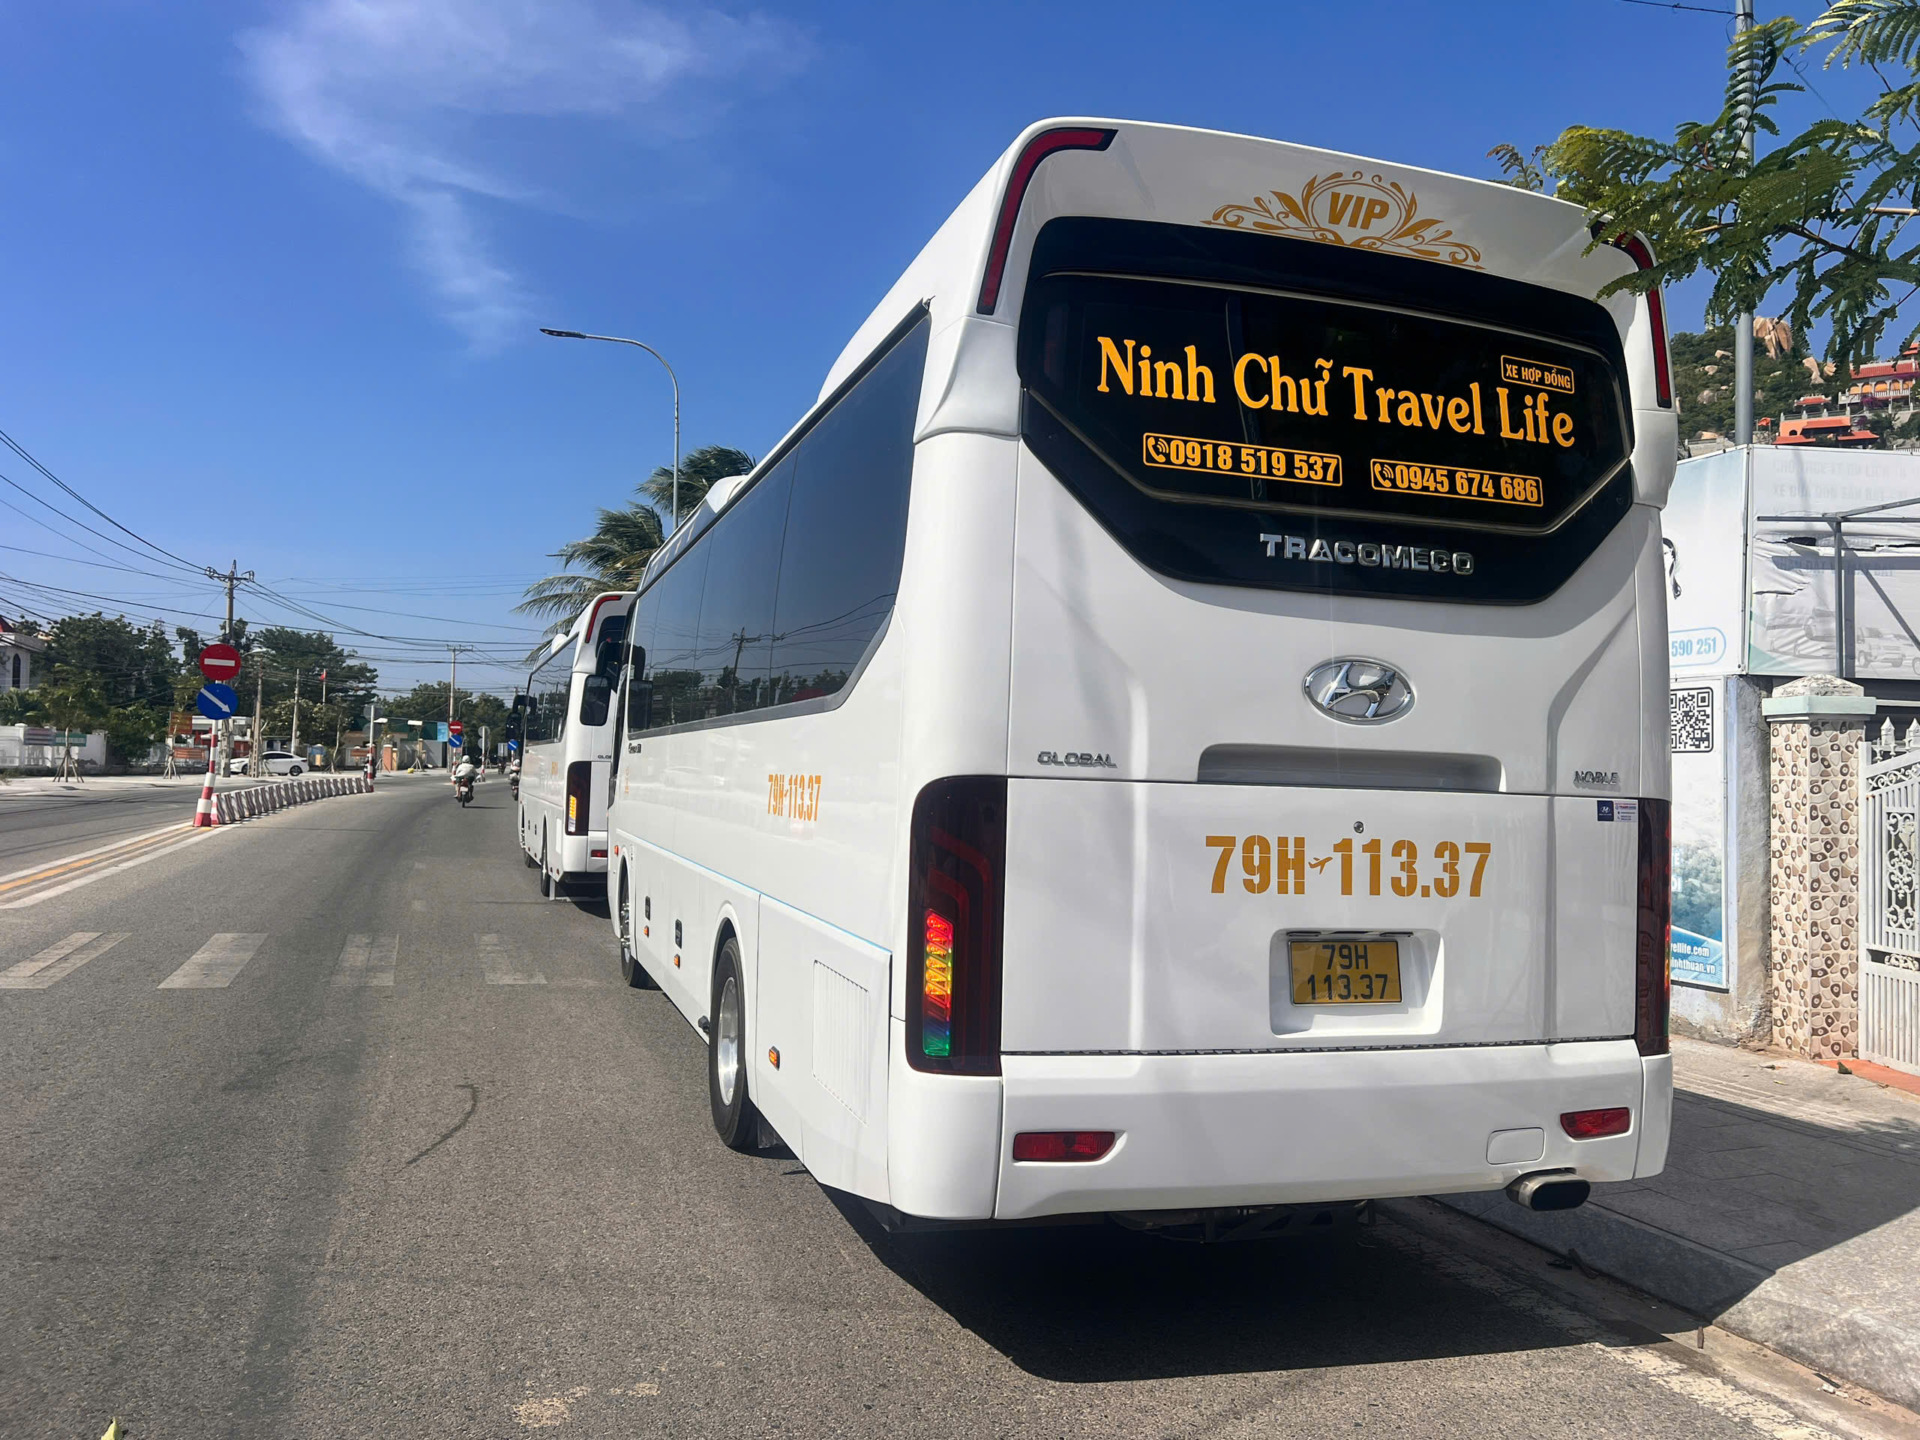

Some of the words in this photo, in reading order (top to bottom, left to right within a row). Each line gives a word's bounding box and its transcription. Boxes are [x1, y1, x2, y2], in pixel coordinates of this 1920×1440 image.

[1328, 192, 1389, 230] VIP
[1097, 336, 1216, 403] Ninh
[1234, 352, 1334, 416] Chữ
[1342, 366, 1485, 435] Travel
[1496, 387, 1575, 447] Life
[1505, 363, 1519, 379] XE
[1521, 366, 1542, 384] HỢP
[1543, 367, 1571, 389] ĐỒNG
[1170, 440, 1233, 470] 0918
[1241, 448, 1286, 476] 519
[1294, 454, 1338, 482] 537
[1395, 465, 1449, 493] 0945
[1455, 472, 1494, 498] 674
[1501, 476, 1538, 503] 686
[1260, 533, 1475, 575] TRACOMECO
[1671, 639, 1693, 658] 590
[1696, 636, 1717, 655] 251
[1037, 751, 1118, 769] GLOBAL
[1573, 770, 1618, 785] NOBLE
[1205, 834, 1306, 895] 79H
[1333, 837, 1492, 898] 113.37
[1322, 944, 1368, 970] 79H
[1308, 974, 1388, 1000] 113.37
